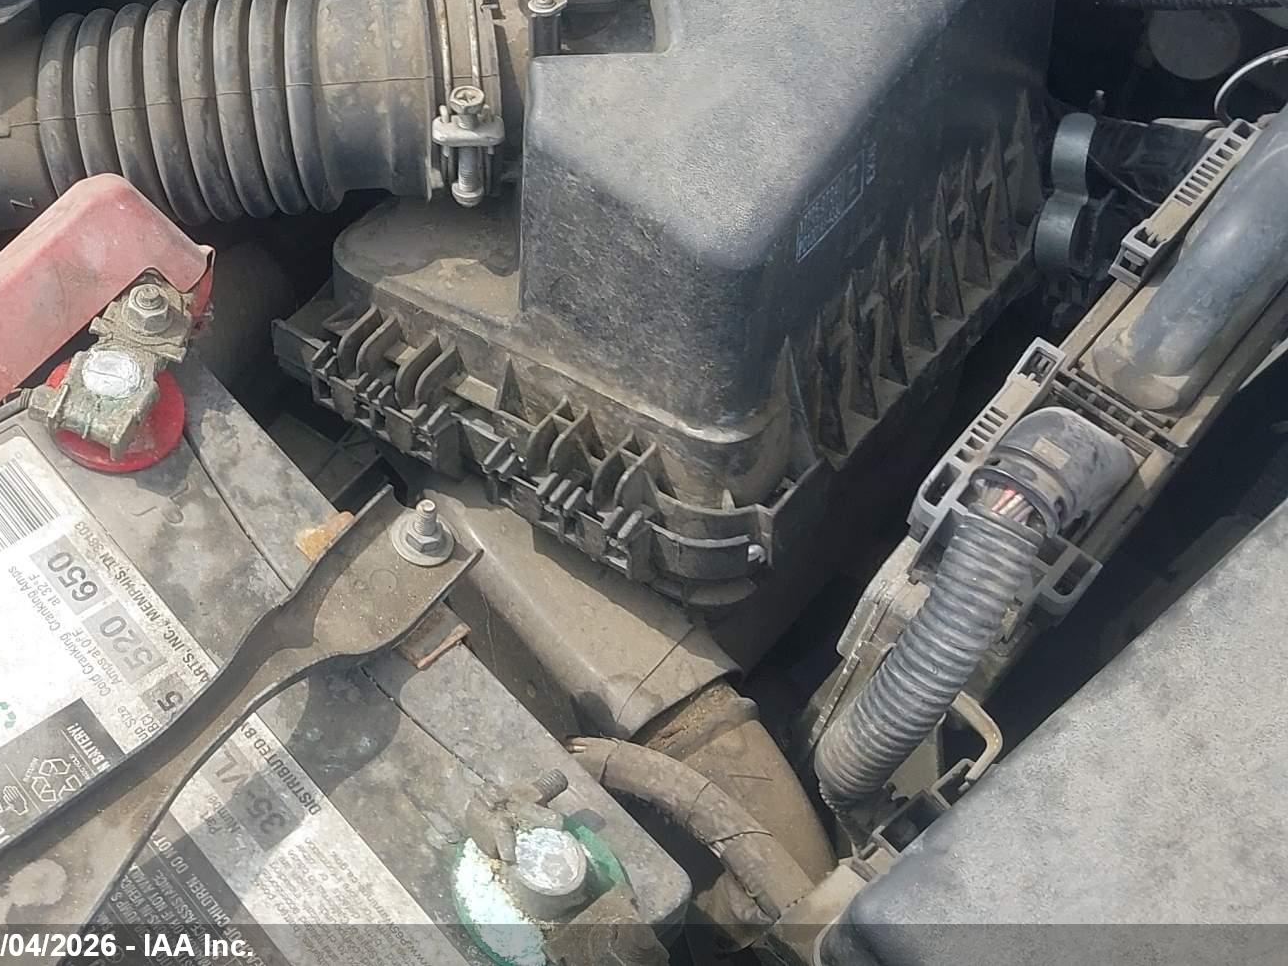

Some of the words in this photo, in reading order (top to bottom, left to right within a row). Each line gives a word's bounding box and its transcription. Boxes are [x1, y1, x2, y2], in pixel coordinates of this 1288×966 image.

[100, 551, 118, 570] TN
[6, 564, 31, 593] Amps
[45, 547, 100, 606] 650
[47, 593, 60, 607] at
[112, 566, 161, 621] MEMPHIS,
[25, 589, 61, 631] Cranking
[58, 631, 95, 675] Cranking
[87, 645, 100, 659] at
[98, 612, 154, 672] 520
[96, 656, 122, 685] Amps
[180, 648, 212, 684] ARTS,
[90, 673, 111, 697] Cold
[156, 687, 184, 713] 5
[116, 704, 137, 727] Size
[66, 721, 105, 765] BATTERY!
[253, 737, 322, 816] DISTRIBUTED
[198, 809, 222, 835] Part
[202, 792, 240, 834] Number
[154, 835, 176, 858] NOT
[169, 854, 188, 874] DO
[147, 890, 168, 912] NOT
[184, 873, 230, 927] CHILDREN.
